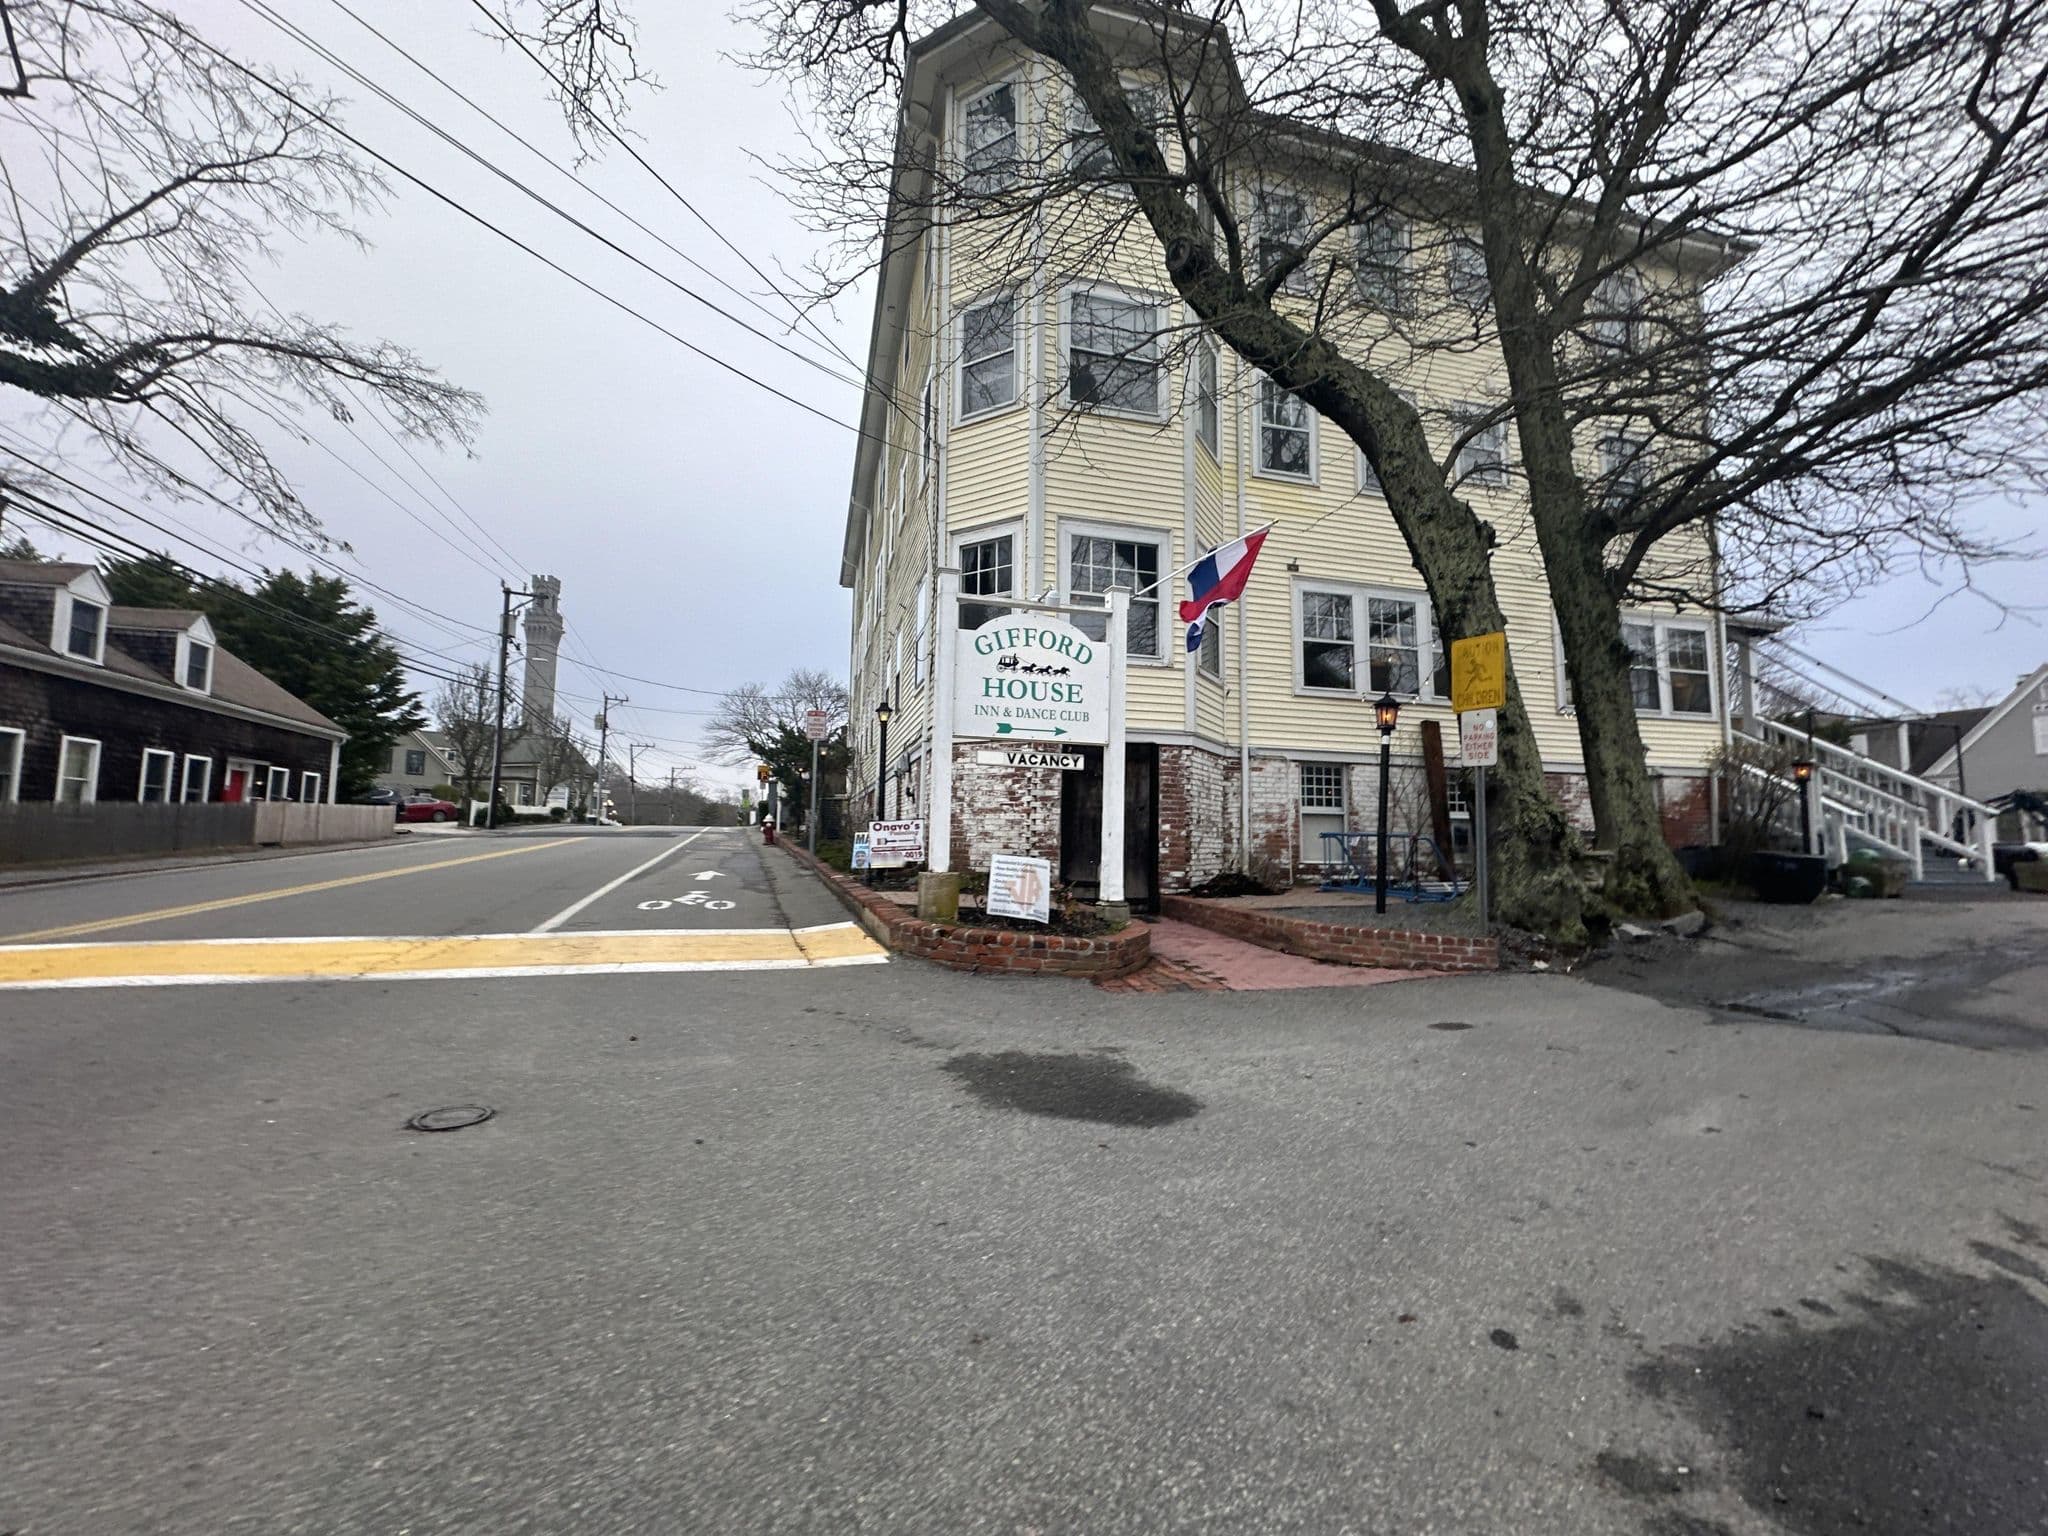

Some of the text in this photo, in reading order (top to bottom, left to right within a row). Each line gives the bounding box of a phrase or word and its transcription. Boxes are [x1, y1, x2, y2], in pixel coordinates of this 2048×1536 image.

[974, 627, 1093, 665] GIFFORD
[982, 677, 1083, 704] HOUSE
[1456, 687, 1501, 708] CHILDREN
[974, 704, 1090, 722] INN & DANCE CLUB
[1473, 723, 1484, 731] NO
[1463, 732, 1495, 740] PARKING
[1465, 742, 1494, 751] EITHER
[1007, 752, 1081, 768] VACANCY
[1468, 751, 1490, 760] SIDE
